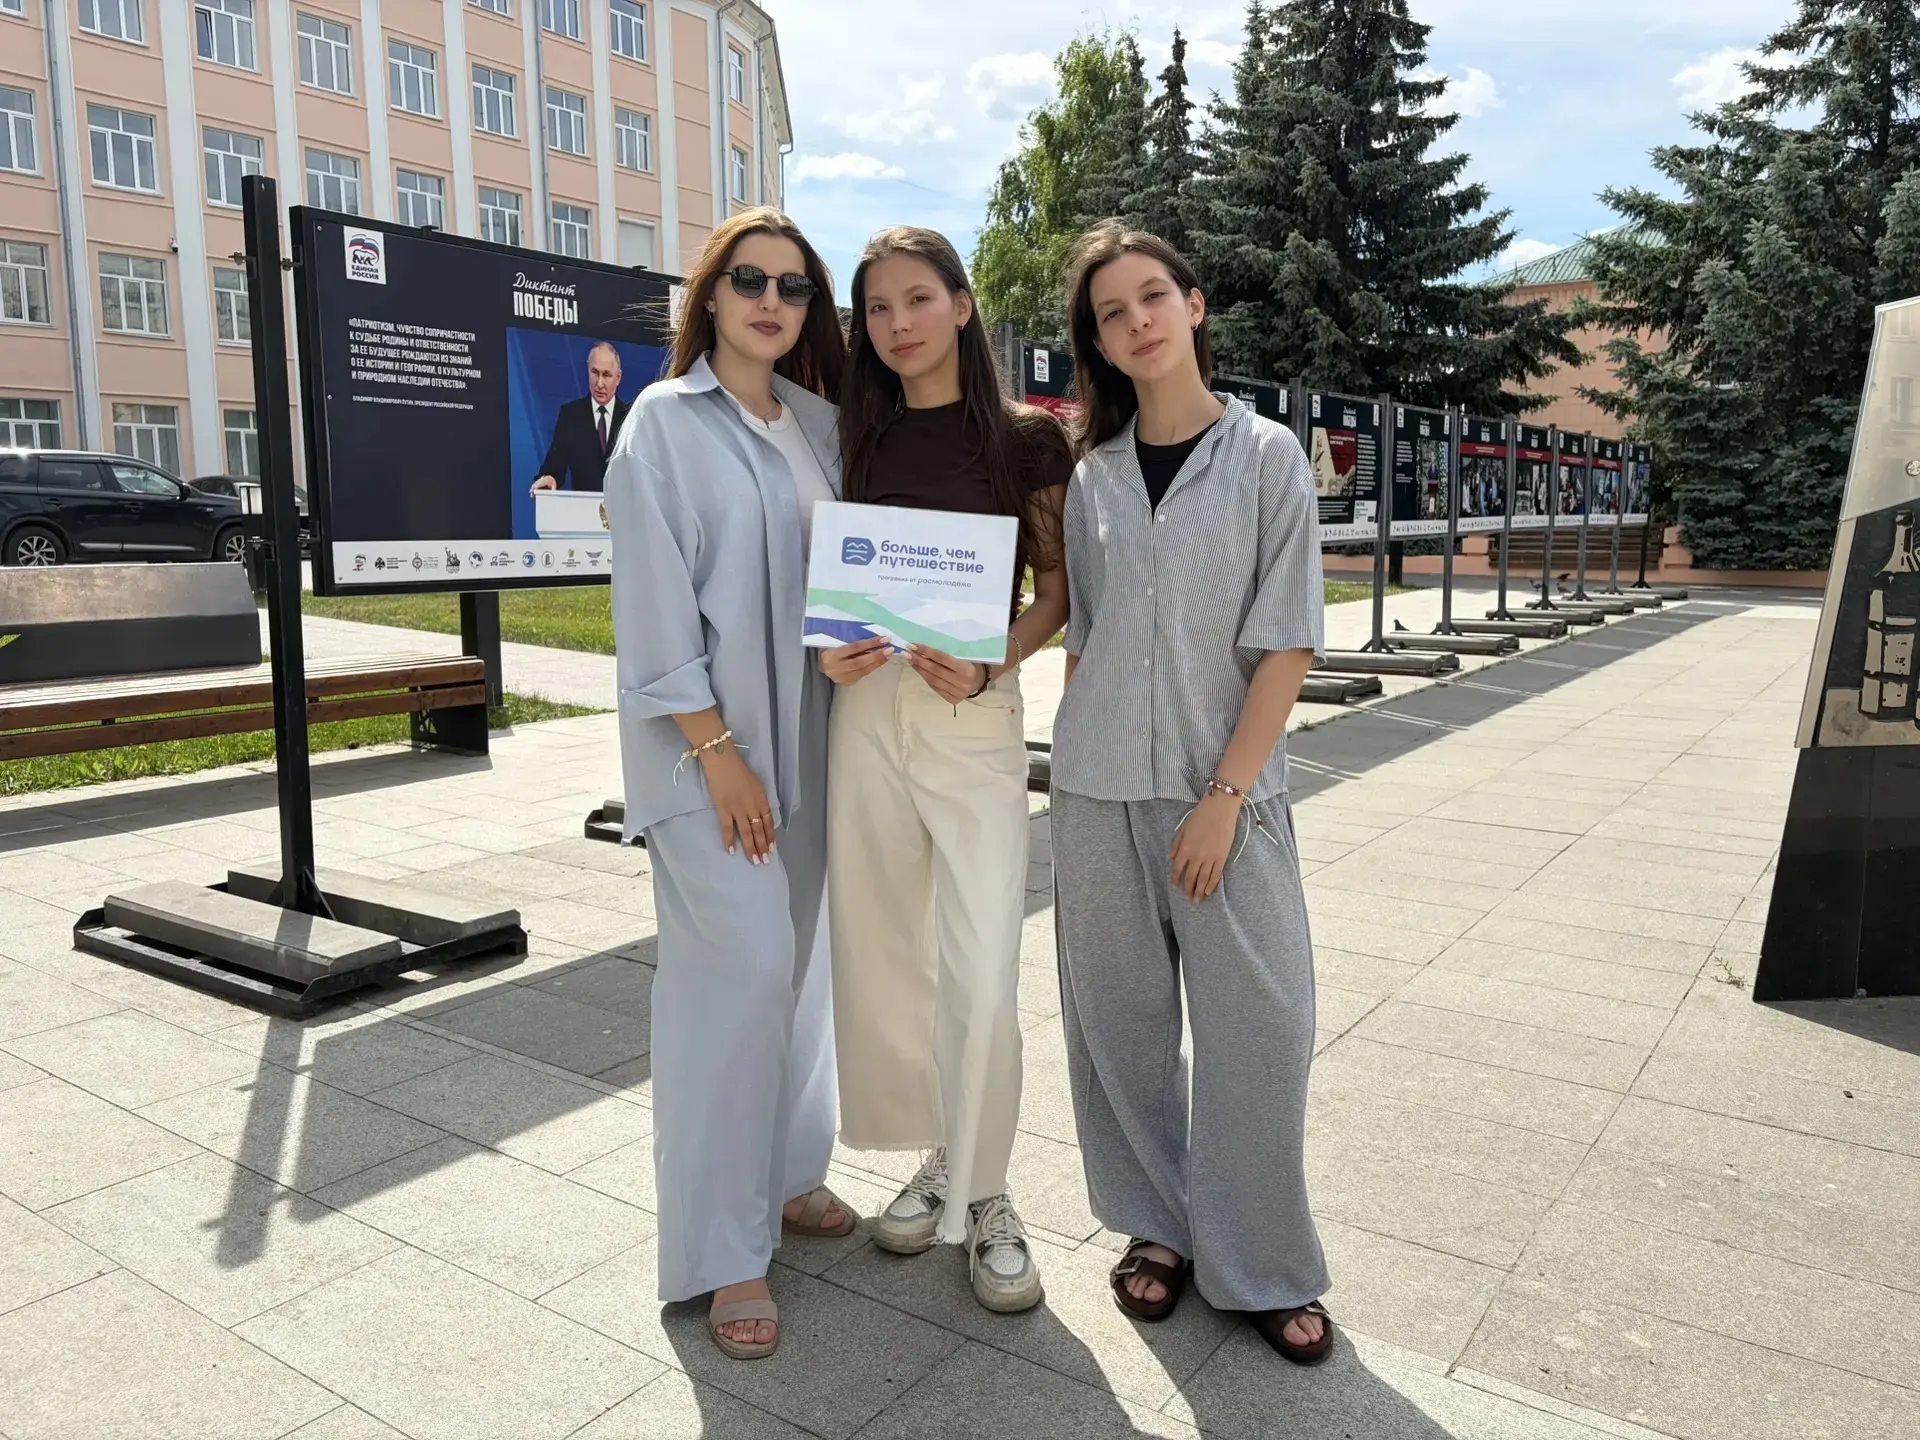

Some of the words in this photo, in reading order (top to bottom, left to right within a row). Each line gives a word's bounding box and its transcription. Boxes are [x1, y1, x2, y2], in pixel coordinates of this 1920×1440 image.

[351, 264, 379, 273] ЕДИНАЯ
[351, 270, 379, 280] РОССИЯ
[512, 271, 577, 297] Диктант
[513, 290, 579, 326] ПОБЕДЫ
[349, 330, 355, 340] К
[355, 331, 381, 344] СУДЬБЕ
[381, 334, 409, 347] РОДИНЫ
[409, 337, 415, 347] И
[415, 338, 469, 353] ОТВЕТСТВЕННОСТИ
[396, 323, 424, 336] ЧУВСТВО
[424, 327, 476, 342] СОПРИЧАСТНОСТИ
[350, 344, 359, 354] ЗА
[360, 345, 368, 355] ЕЕ
[368, 346, 401, 359] БУДУЩЕЕ
[401, 349, 440, 362] РОЖДАЮТСЯ
[440, 354, 449, 363] ИЗ
[449, 355, 473, 366] ЗНАНИЙ
[350, 357, 356, 367] О
[356, 357, 365, 368] ЕЕ
[365, 358, 394, 371] ИСТОРИИ
[394, 361, 400, 371] И
[437, 365, 442, 375] О
[442, 366, 482, 379] КУЛЬТУРНОМ
[351, 370, 357, 380] И
[357, 370, 397, 384] ПРИРОДНОМ
[397, 374, 431, 387] НАСЛЕДИИ
[880, 539, 943, 559] больше,
[945, 548, 976, 560] чем
[879, 554, 985, 574] путешествие
